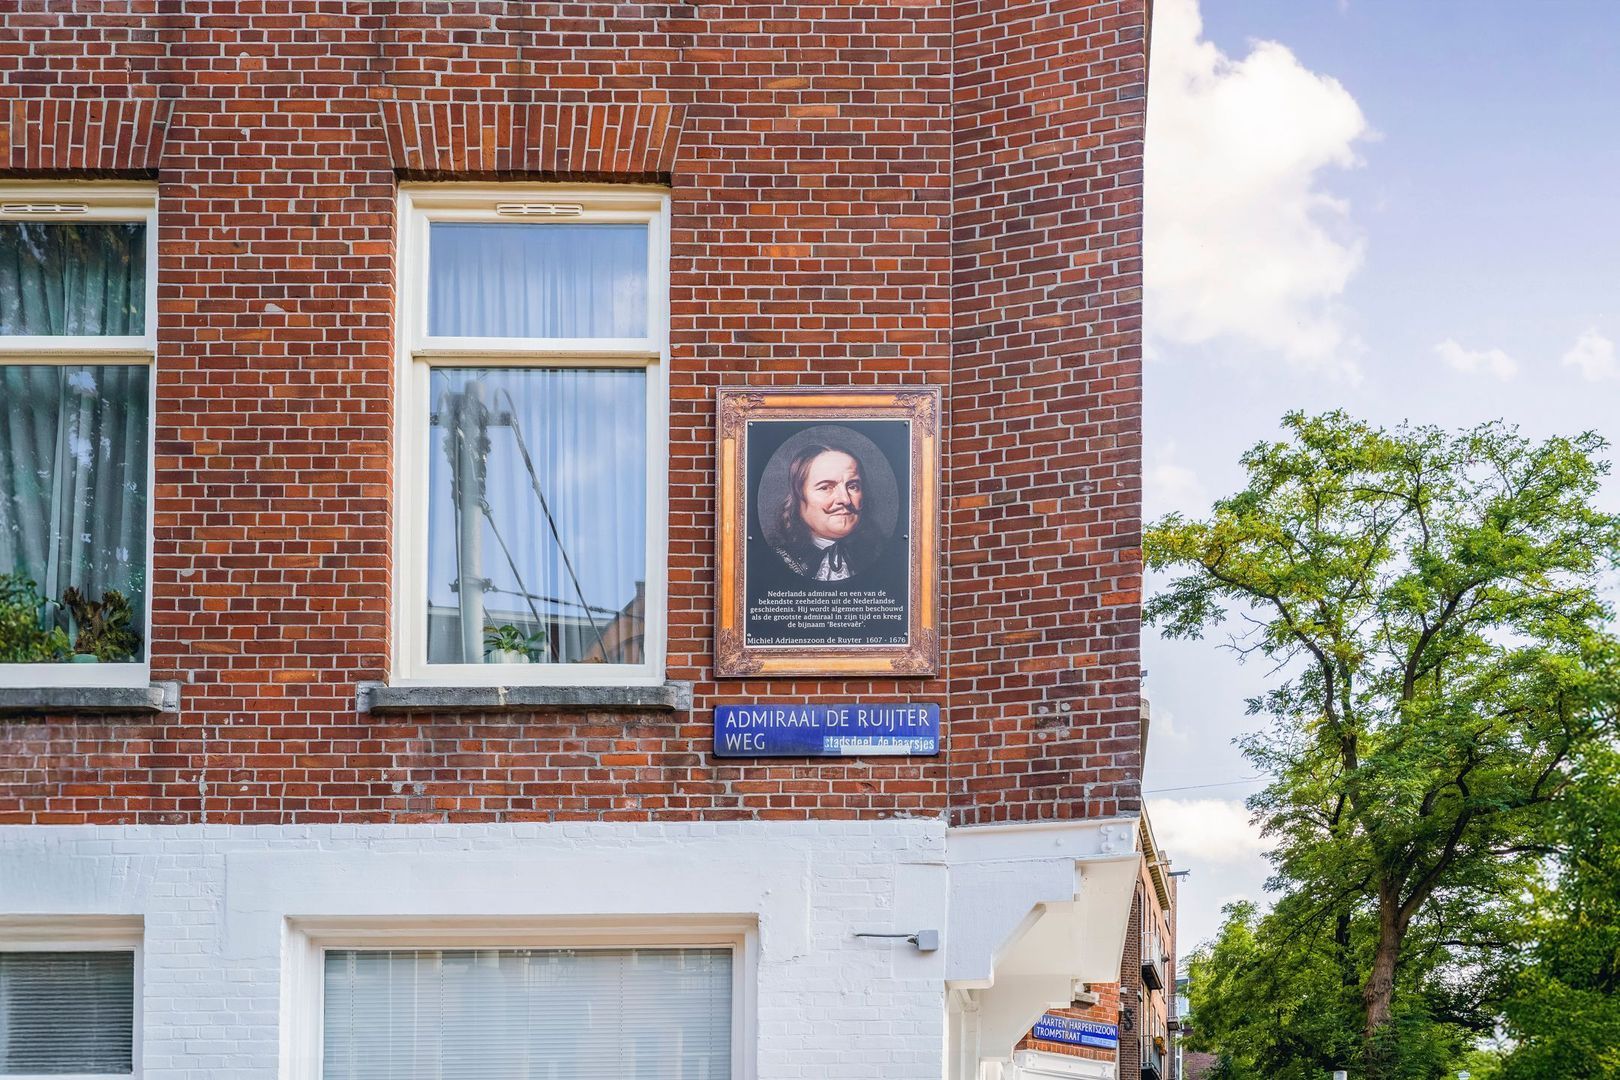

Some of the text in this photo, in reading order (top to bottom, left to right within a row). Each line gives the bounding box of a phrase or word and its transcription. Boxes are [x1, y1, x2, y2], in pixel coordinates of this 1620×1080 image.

[750, 606, 796, 614] geschiedenis.
[844, 613, 858, 621] zijn
[859, 613, 871, 621] tijd
[798, 621, 826, 629] bijnaam
[725, 709, 930, 732] ADMIRAAL DE RUIJTER
[725, 733, 766, 751] WEG
[1036, 1027, 1081, 1041] TROMPSTRAAT
[1069, 1021, 1116, 1036] HARPERTSZOON
